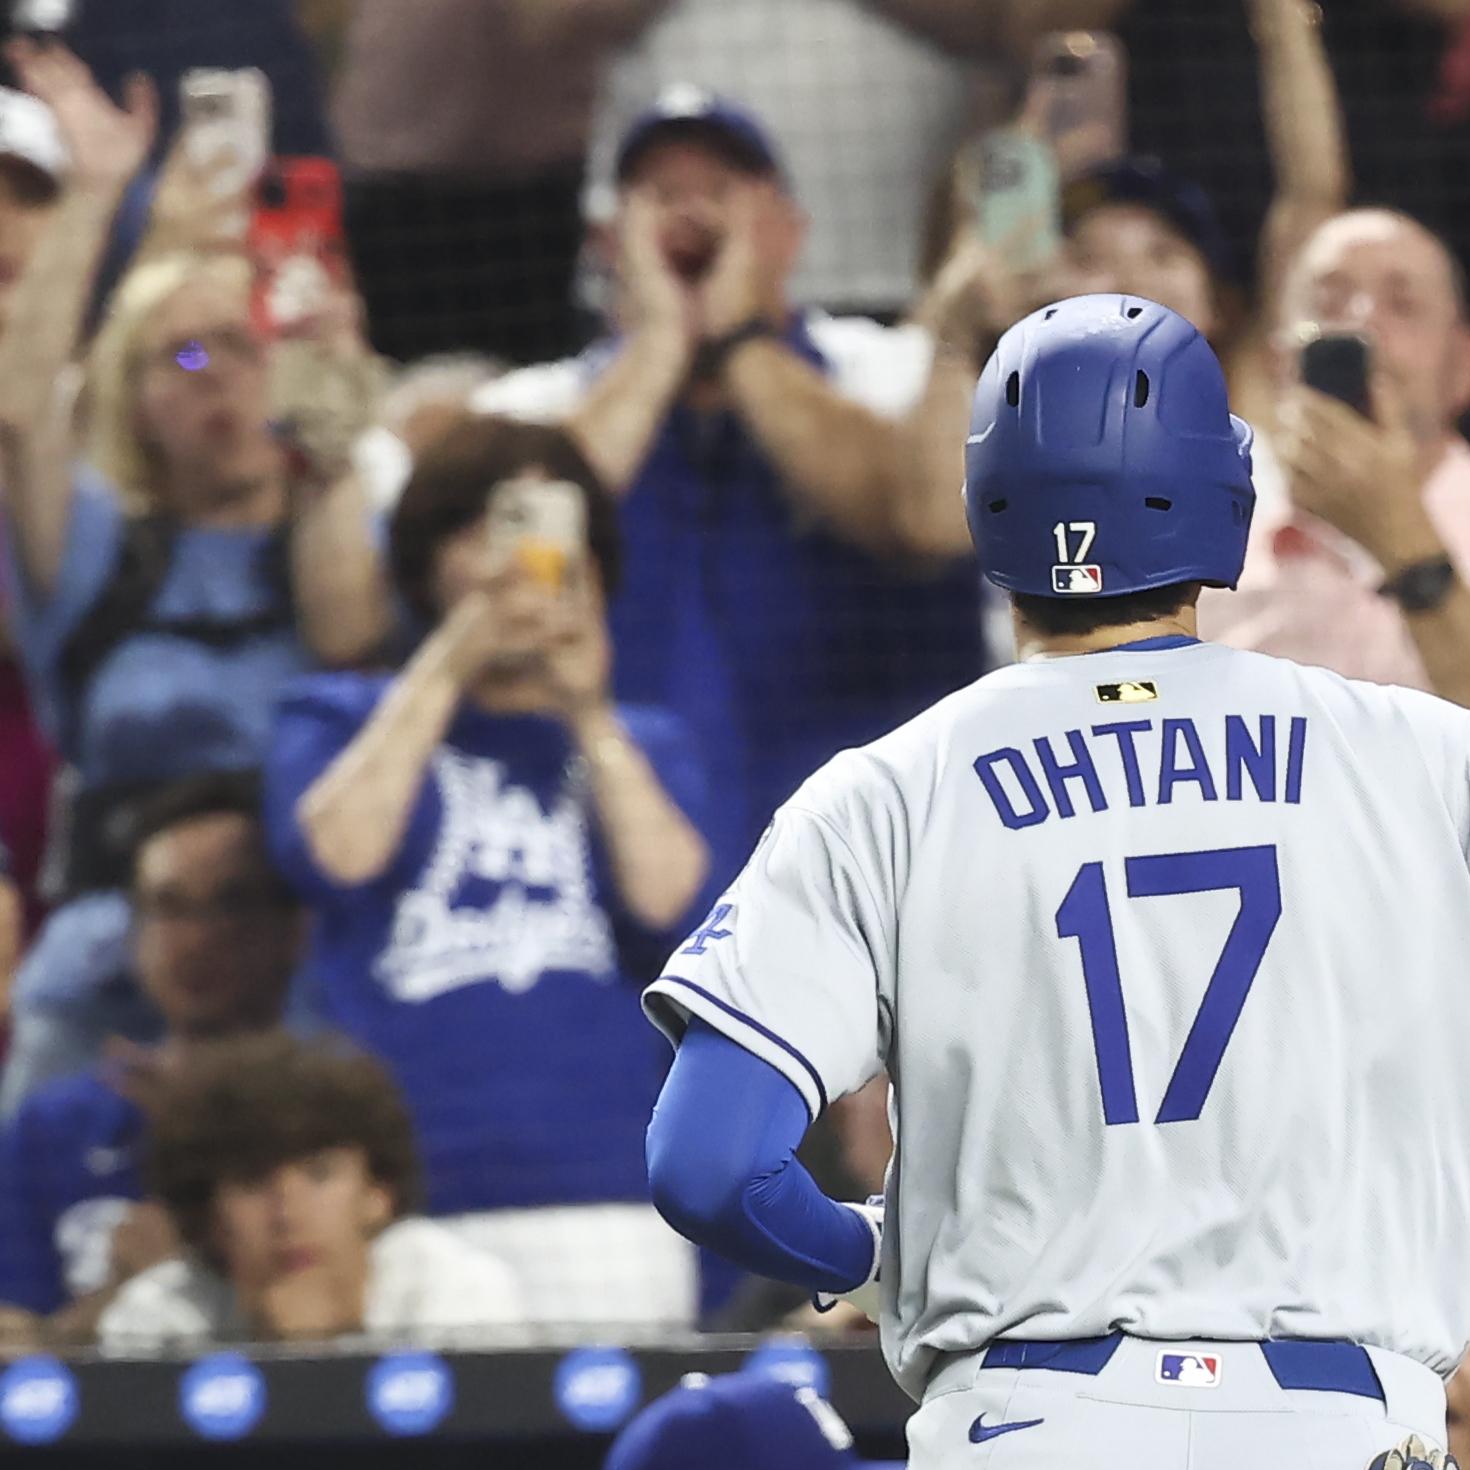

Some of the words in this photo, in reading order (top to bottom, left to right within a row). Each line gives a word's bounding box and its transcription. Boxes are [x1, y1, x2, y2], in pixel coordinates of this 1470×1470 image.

[1053, 521, 1096, 563] 17
[972, 714, 1308, 831] OHTANI
[1055, 844, 1283, 1126] 17
